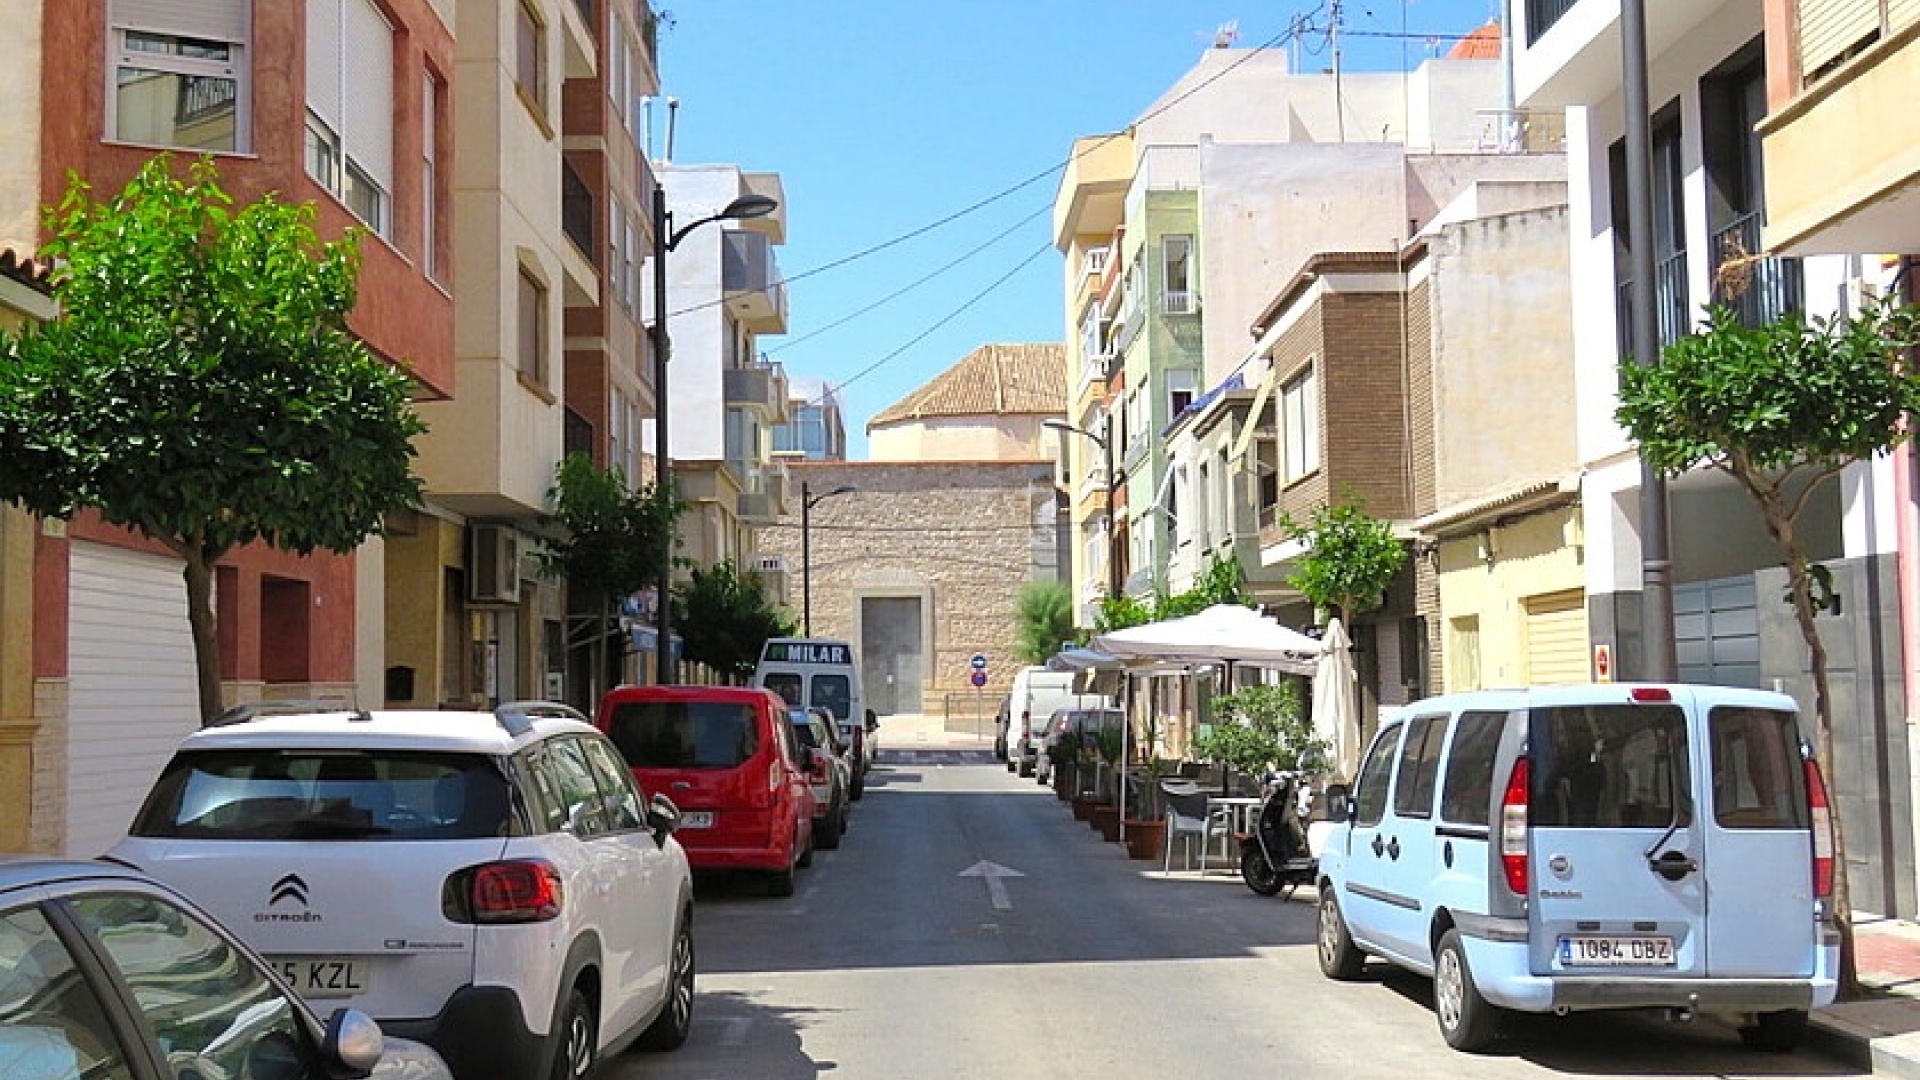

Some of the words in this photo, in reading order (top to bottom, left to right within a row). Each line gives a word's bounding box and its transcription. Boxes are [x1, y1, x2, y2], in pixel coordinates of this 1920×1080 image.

[787, 644, 844, 662] MILAR
[1578, 939, 1623, 959] 1084
[308, 962, 361, 989] KZL
